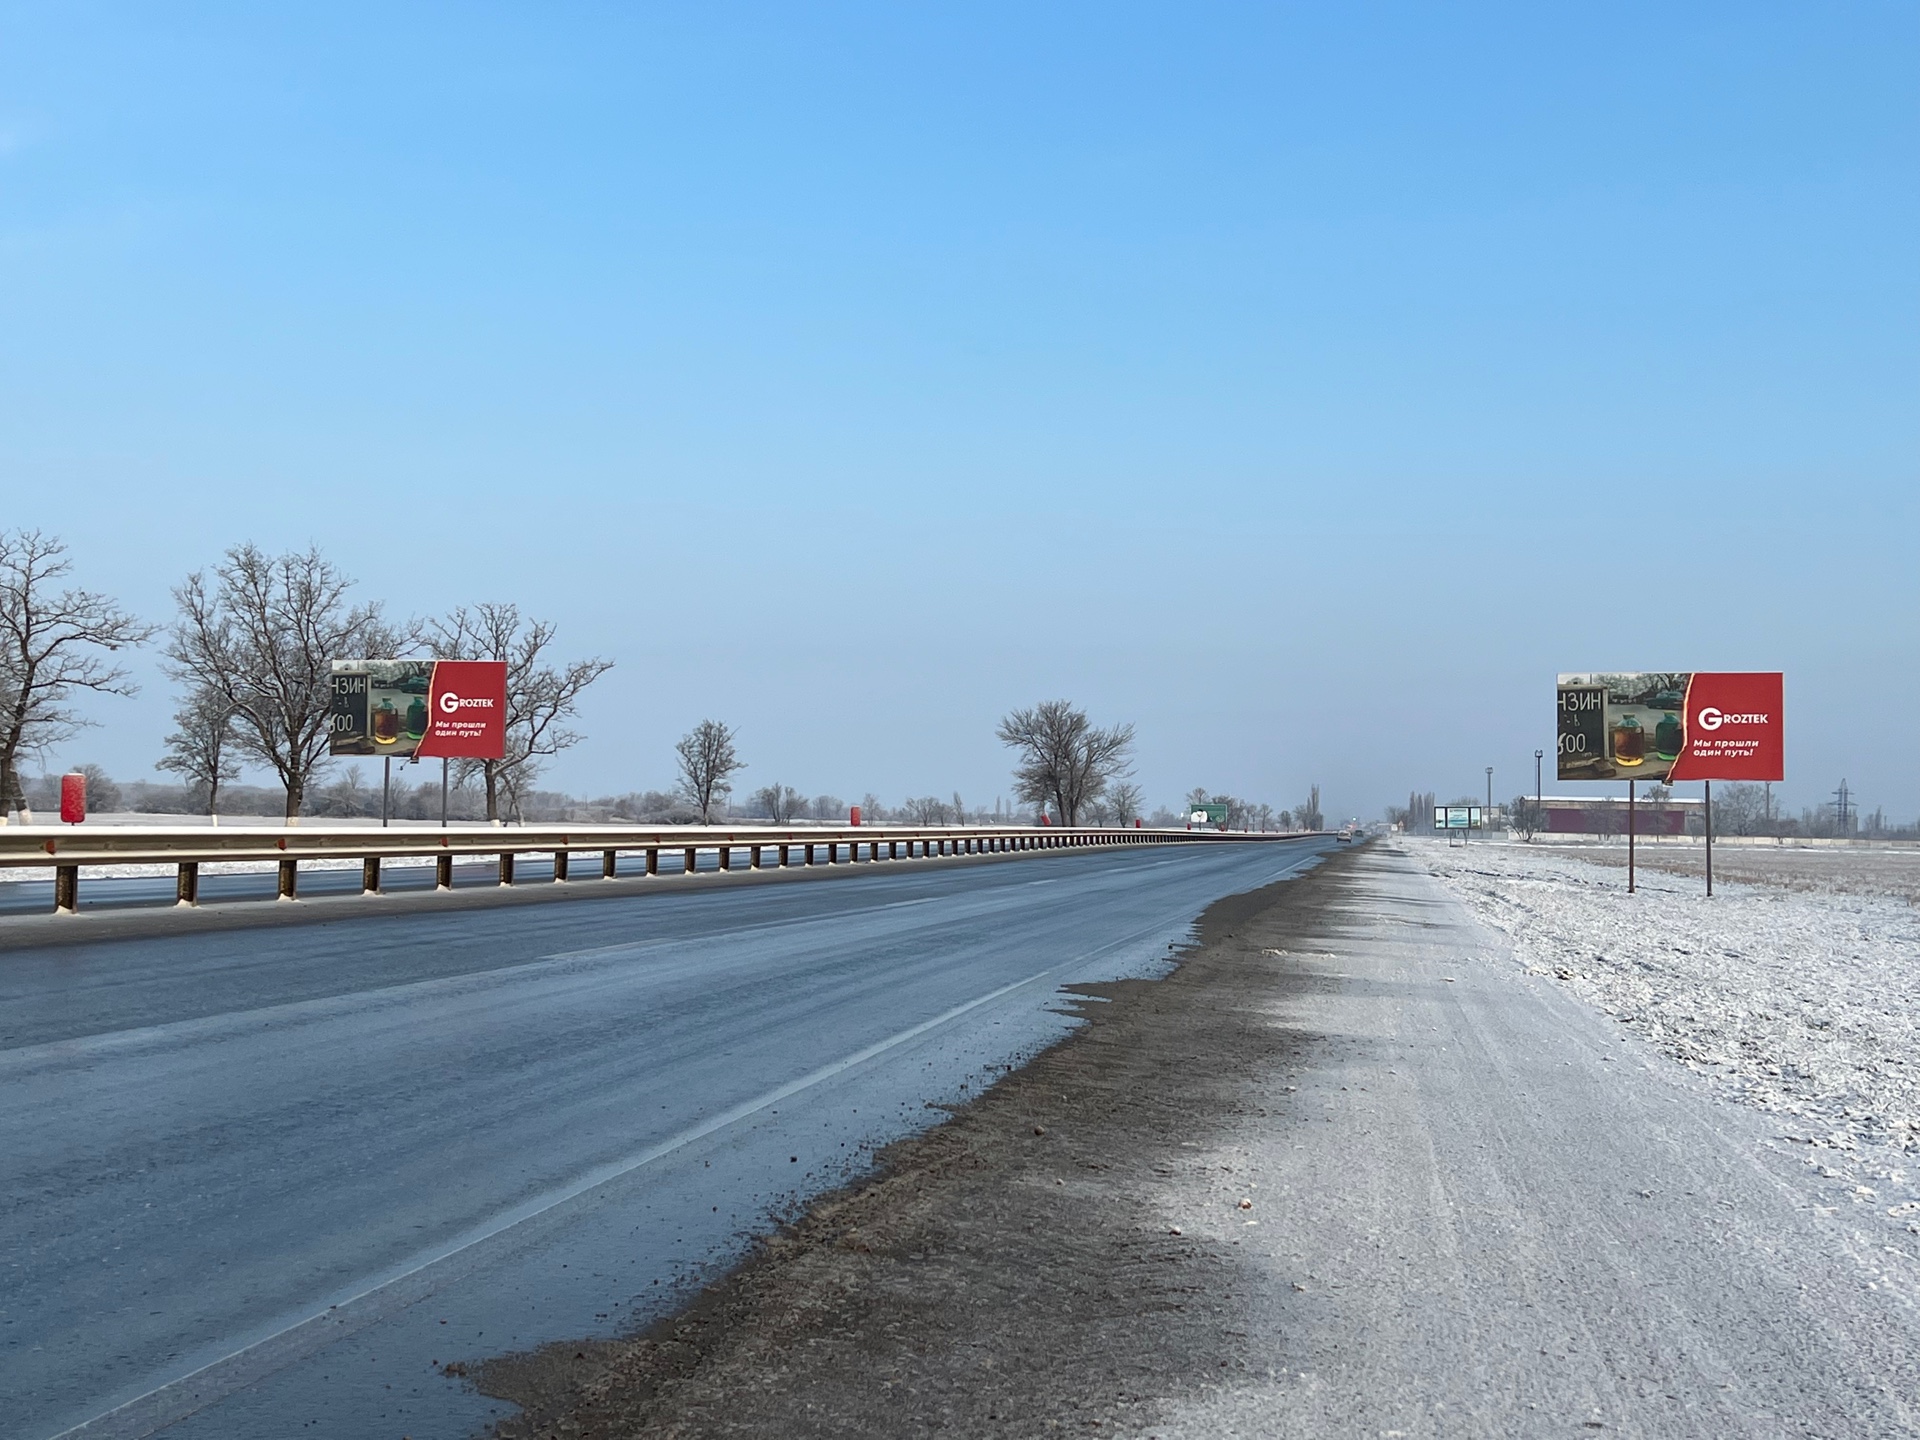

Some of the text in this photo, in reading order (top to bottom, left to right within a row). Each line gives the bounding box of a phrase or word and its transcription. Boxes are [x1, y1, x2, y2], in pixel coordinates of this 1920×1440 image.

[440, 692, 494, 713] GROZTEK
[1698, 707, 1769, 731] GROZTEK
[459, 729, 482, 738] путь!
[1693, 739, 1759, 749] Мы прошли
[1693, 748, 1754, 758] один путь!
